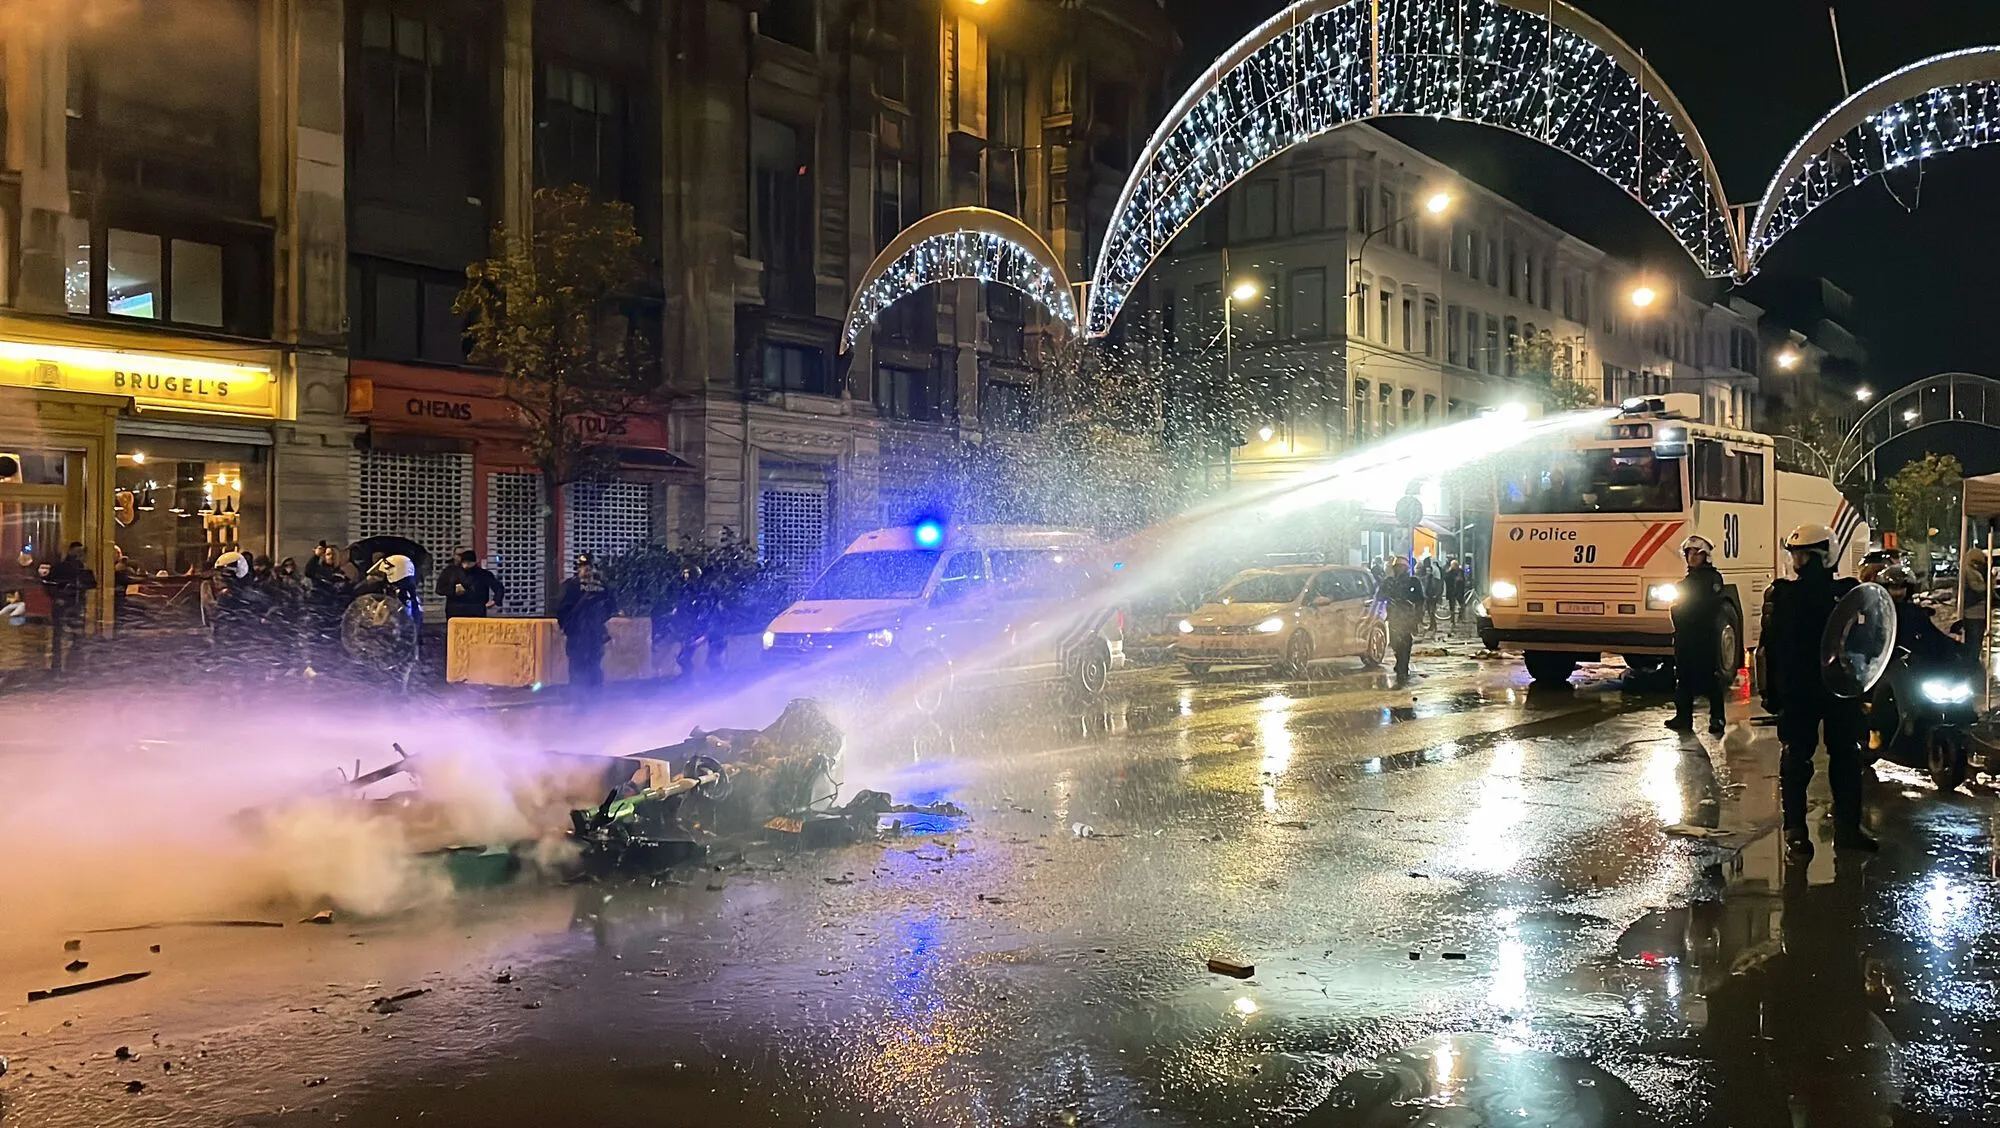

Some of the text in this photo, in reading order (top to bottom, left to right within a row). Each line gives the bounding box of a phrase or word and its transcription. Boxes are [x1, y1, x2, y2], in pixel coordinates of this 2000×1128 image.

[114, 371, 228, 396] BRUGEL'S
[406, 398, 472, 420] CHEMS
[1530, 528, 1576, 541] Police
[1724, 513, 1739, 558] 30
[1574, 545, 1596, 563] 30
